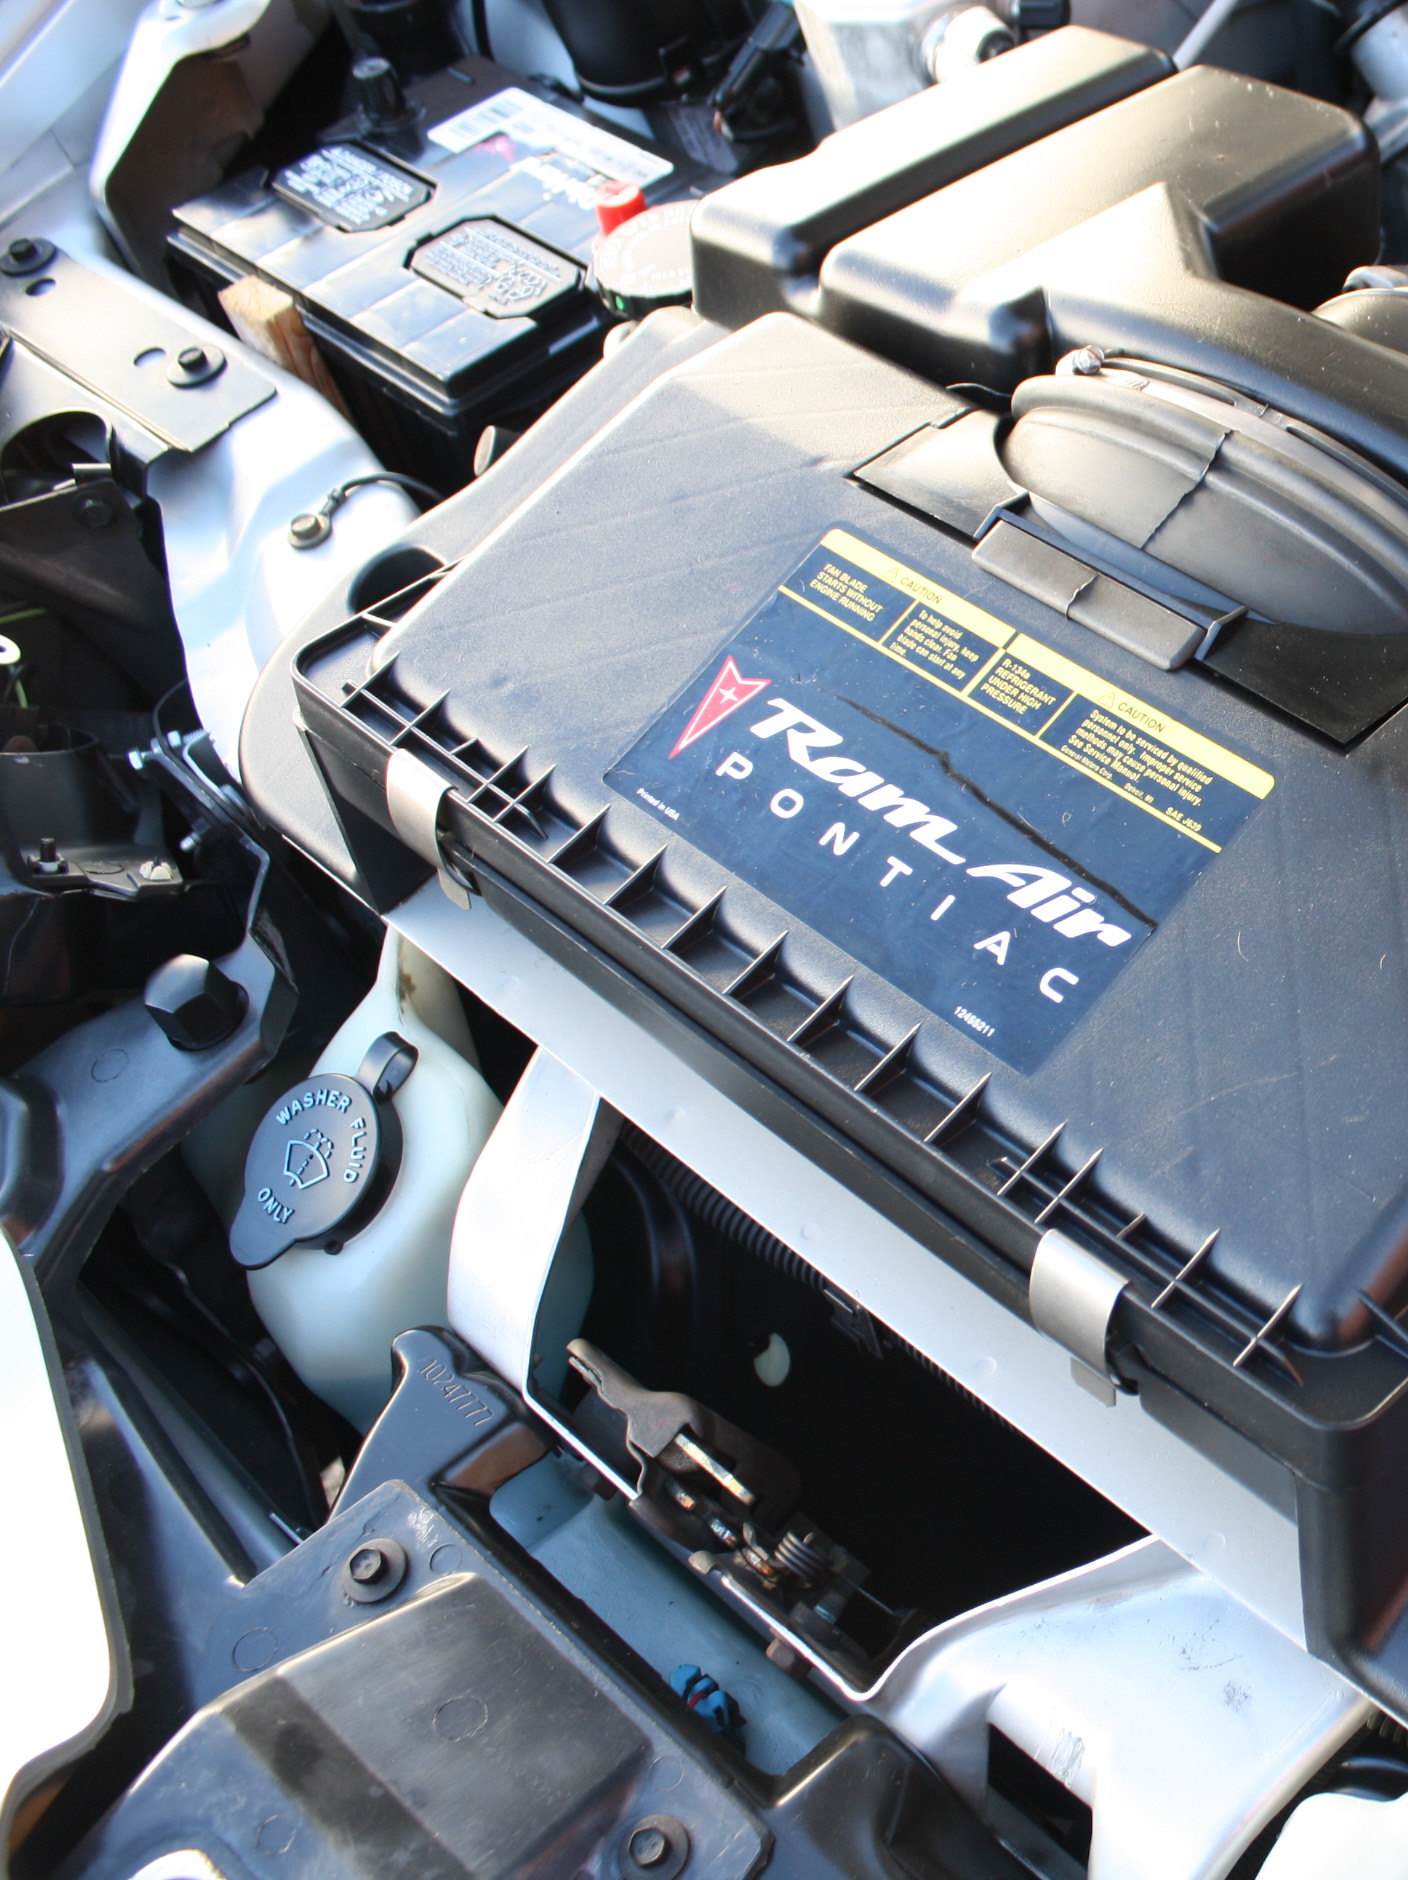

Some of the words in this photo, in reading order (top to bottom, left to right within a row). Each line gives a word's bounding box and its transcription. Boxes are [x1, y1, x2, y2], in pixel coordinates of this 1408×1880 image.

[816, 571, 848, 593] STARTS
[845, 587, 883, 613] WITHOUT
[823, 563, 841, 577] FAN
[838, 572, 868, 593] BLADE
[900, 576, 941, 604] CAUTION
[809, 578, 841, 601] ENGINE
[837, 595, 875, 621] RUNNING
[994, 666, 1056, 705] REFRIGERANT
[1001, 658, 1030, 679] R-134a
[980, 682, 1027, 714] PRESSURE
[987, 674, 1019, 697] UNDER
[1017, 692, 1041, 709] HIGH
[1117, 701, 1164, 732] CAUTION
[1080, 718, 1120, 743] personnel
[1139, 750, 1175, 776] Improper
[1172, 772, 1202, 792] service
[1089, 709, 1117, 730] System
[1116, 724, 1126, 735] to
[1124, 729, 1136, 741] be
[1135, 737, 1169, 759] serviced
[1166, 754, 1178, 766] by
[1176, 761, 1213, 784] qualified
[749, 697, 966, 864] Ram
[966, 863, 1131, 947] Air
[1165, 806, 1184, 821] SAE
[715, 752, 1079, 1003] PONTIAC
[276, 1089, 351, 1125] WASHER
[343, 1117, 366, 1183] FLUID
[258, 1187, 295, 1224] ONLY
